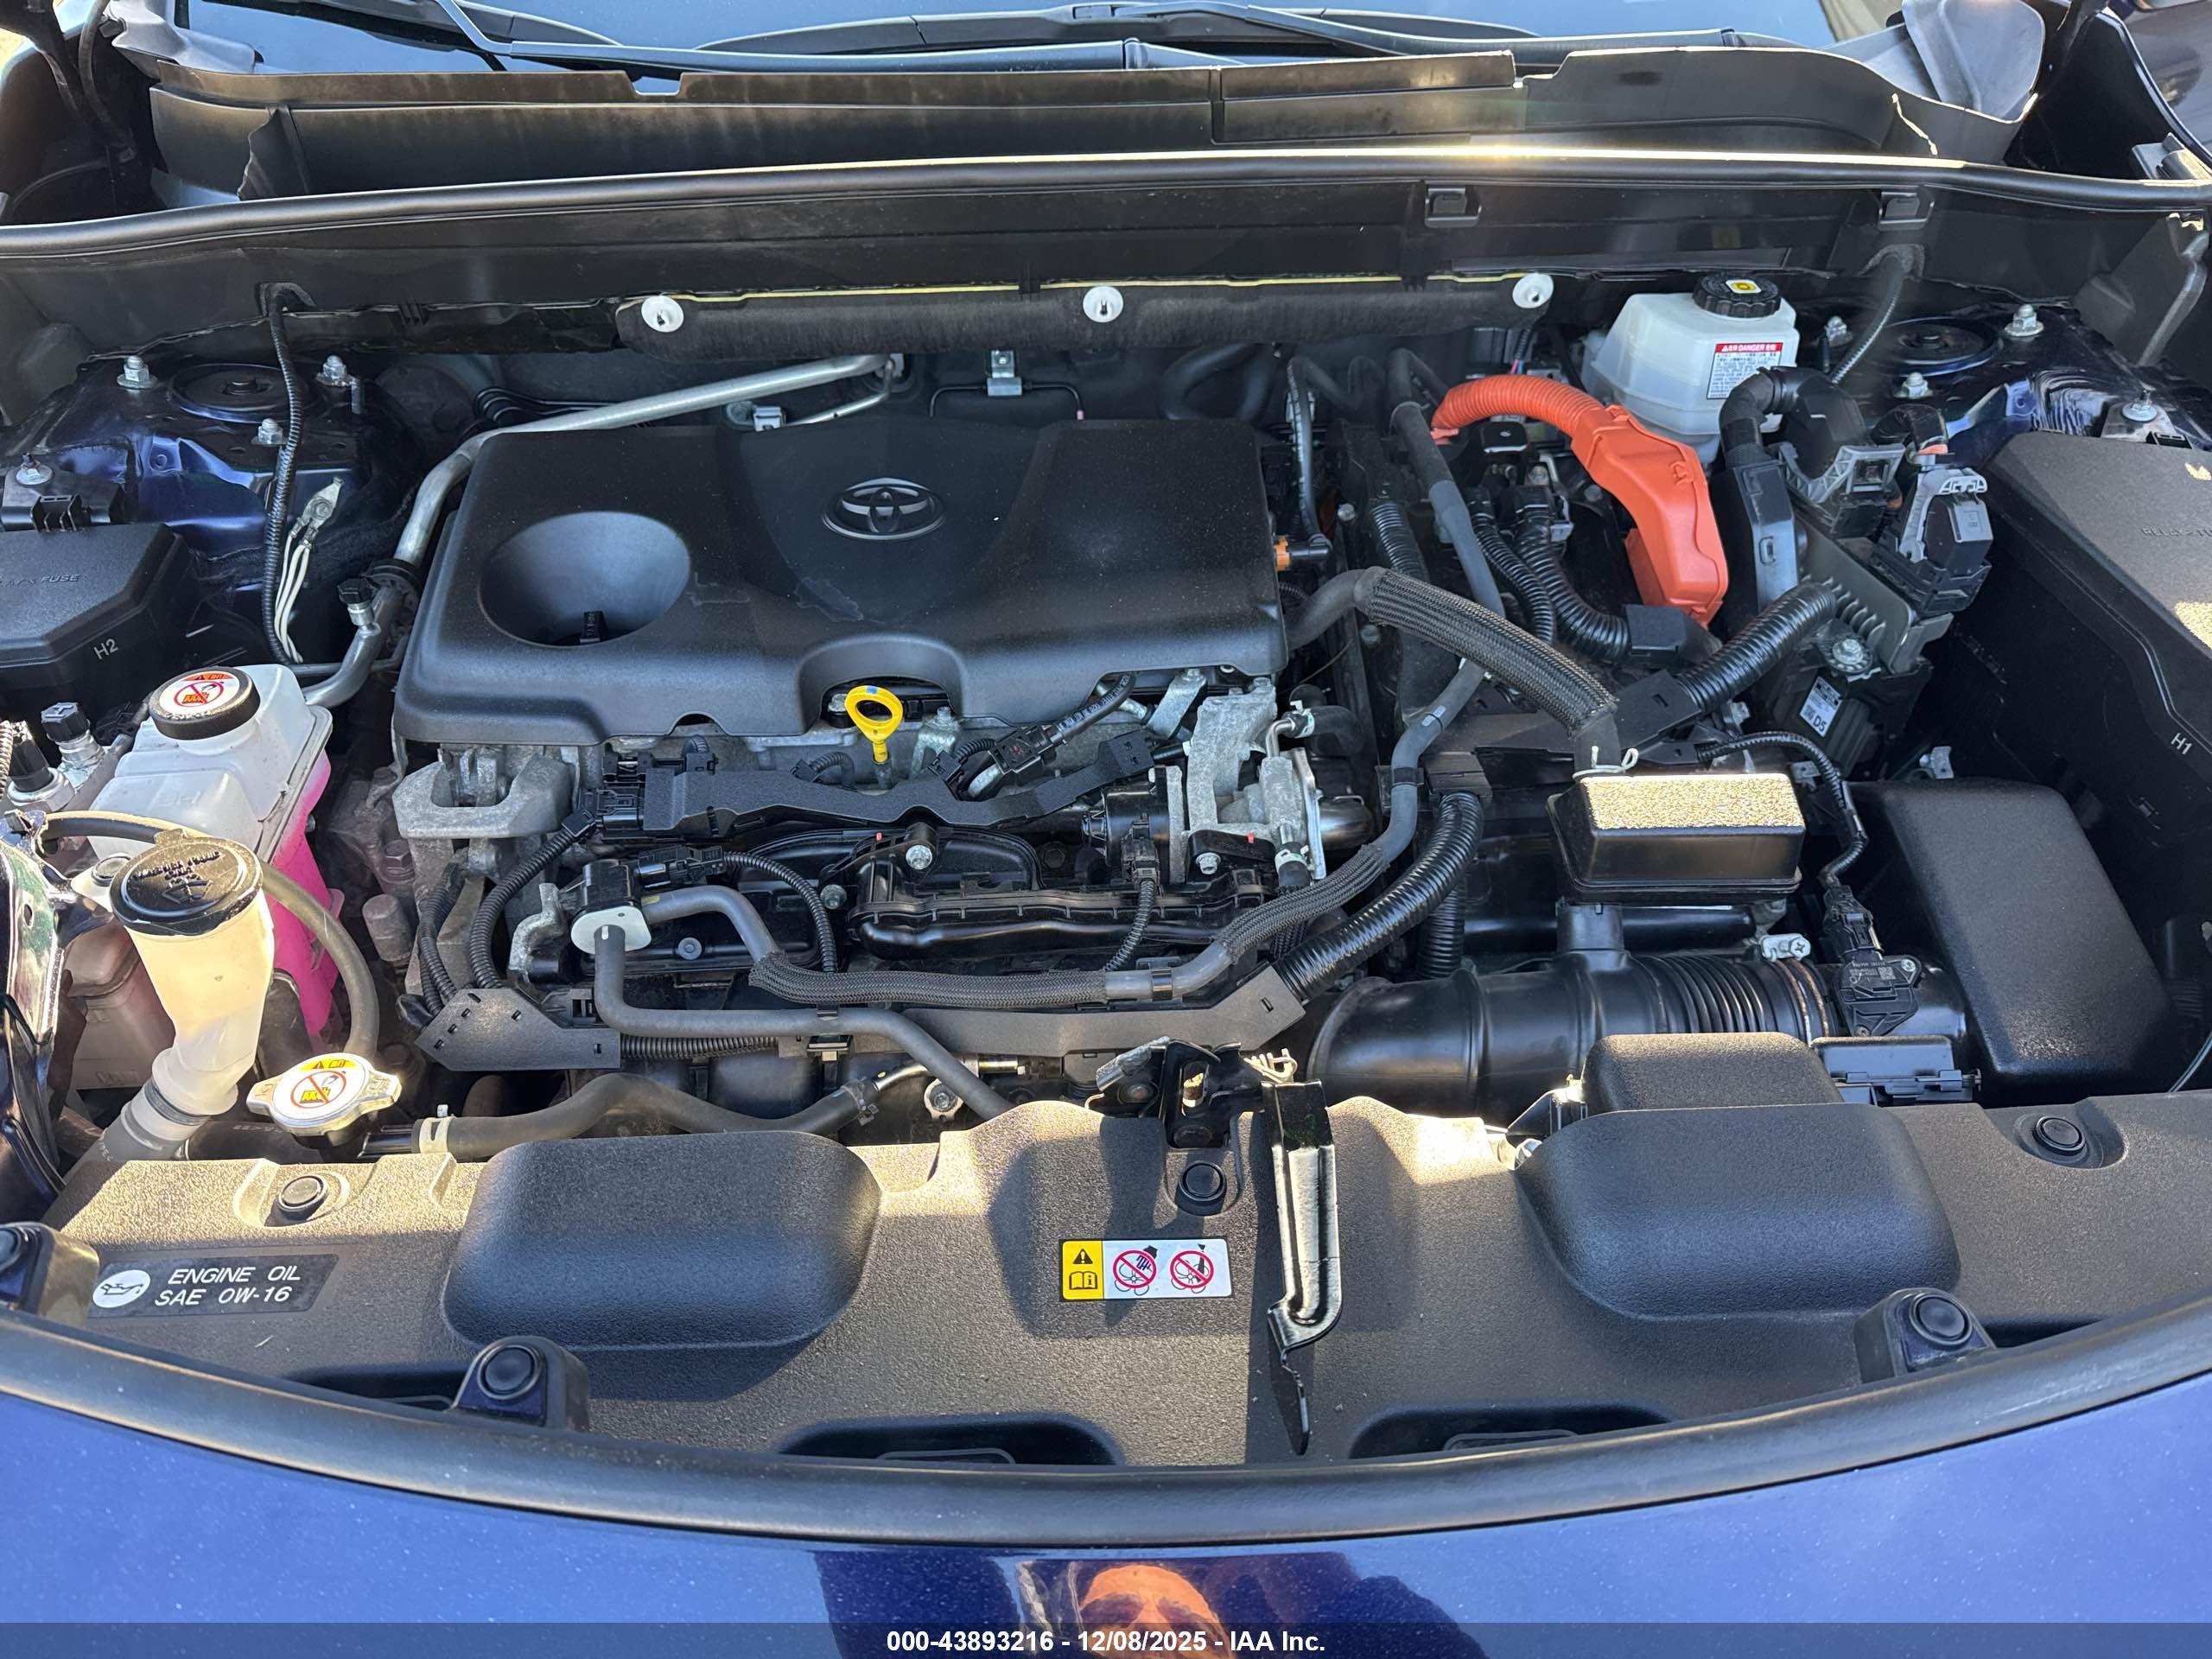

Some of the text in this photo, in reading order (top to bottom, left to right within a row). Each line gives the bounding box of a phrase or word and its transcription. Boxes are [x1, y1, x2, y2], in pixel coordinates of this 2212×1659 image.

[41, 574, 81, 582] FUSE
[93, 638, 119, 660] H2
[1813, 715, 1827, 732] D5
[2171, 732, 2192, 755] H1
[168, 1264, 301, 1286] ENGINE OIL
[154, 1285, 294, 1307] SAE 0W-16
